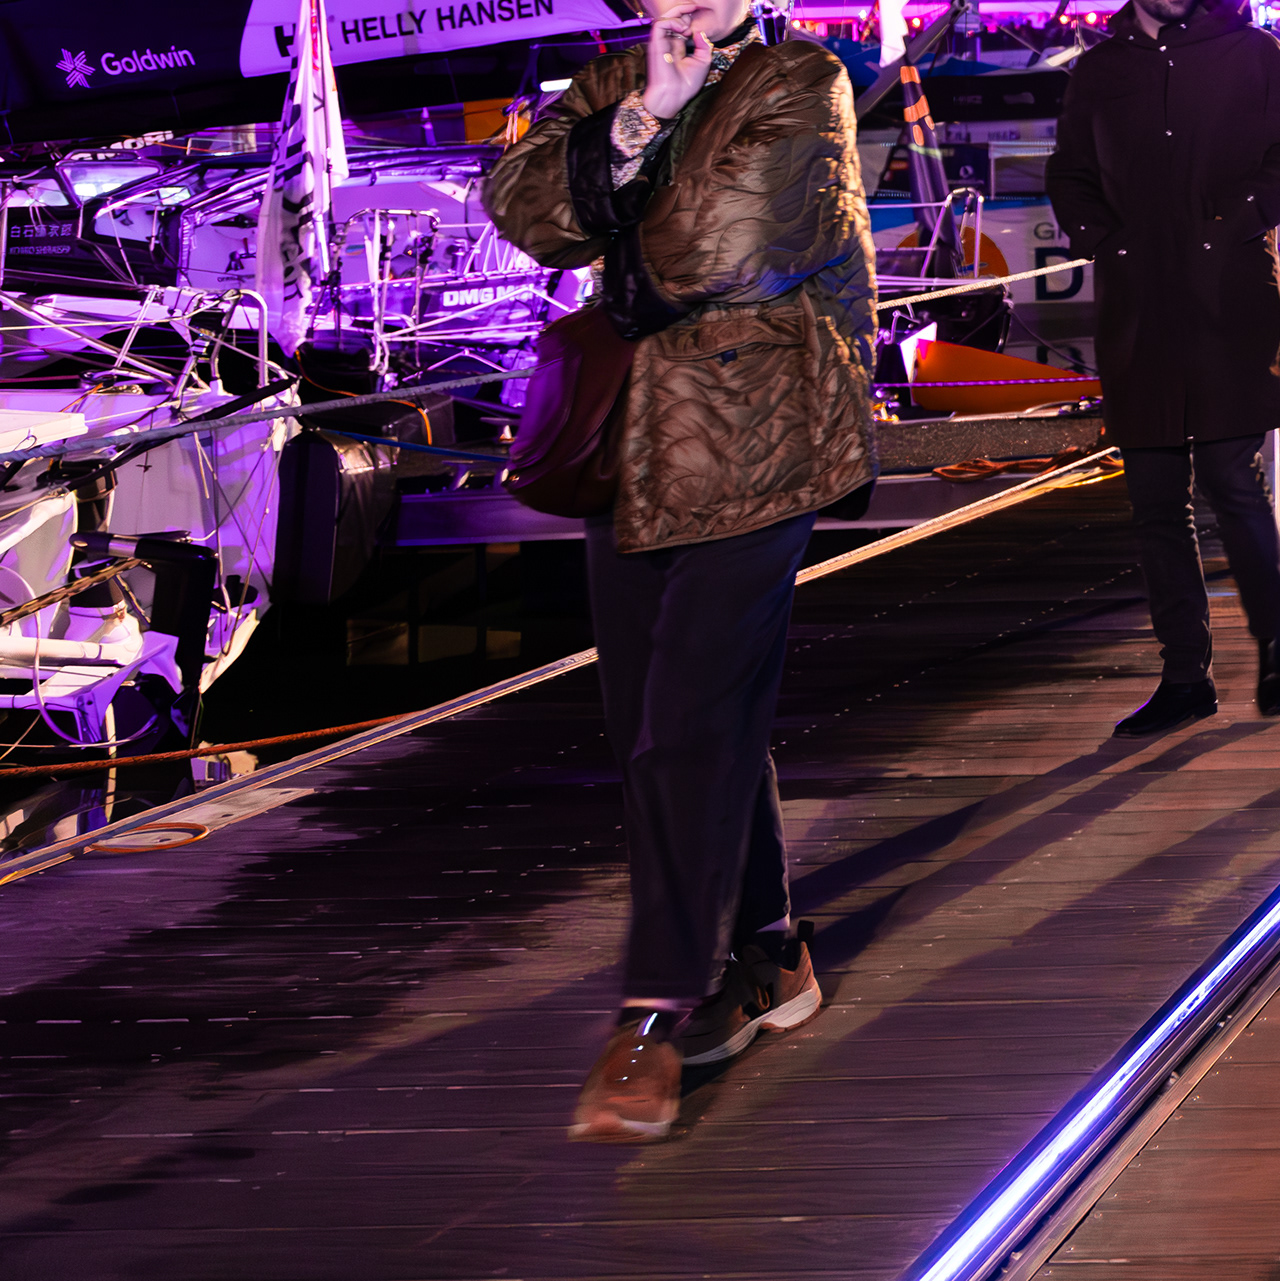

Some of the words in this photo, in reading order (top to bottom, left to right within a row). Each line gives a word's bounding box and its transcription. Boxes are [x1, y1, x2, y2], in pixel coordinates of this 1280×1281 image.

[342, 8, 426, 46] HELLY
[101, 45, 196, 76] Goldwin
[443, 286, 495, 306] DMG
